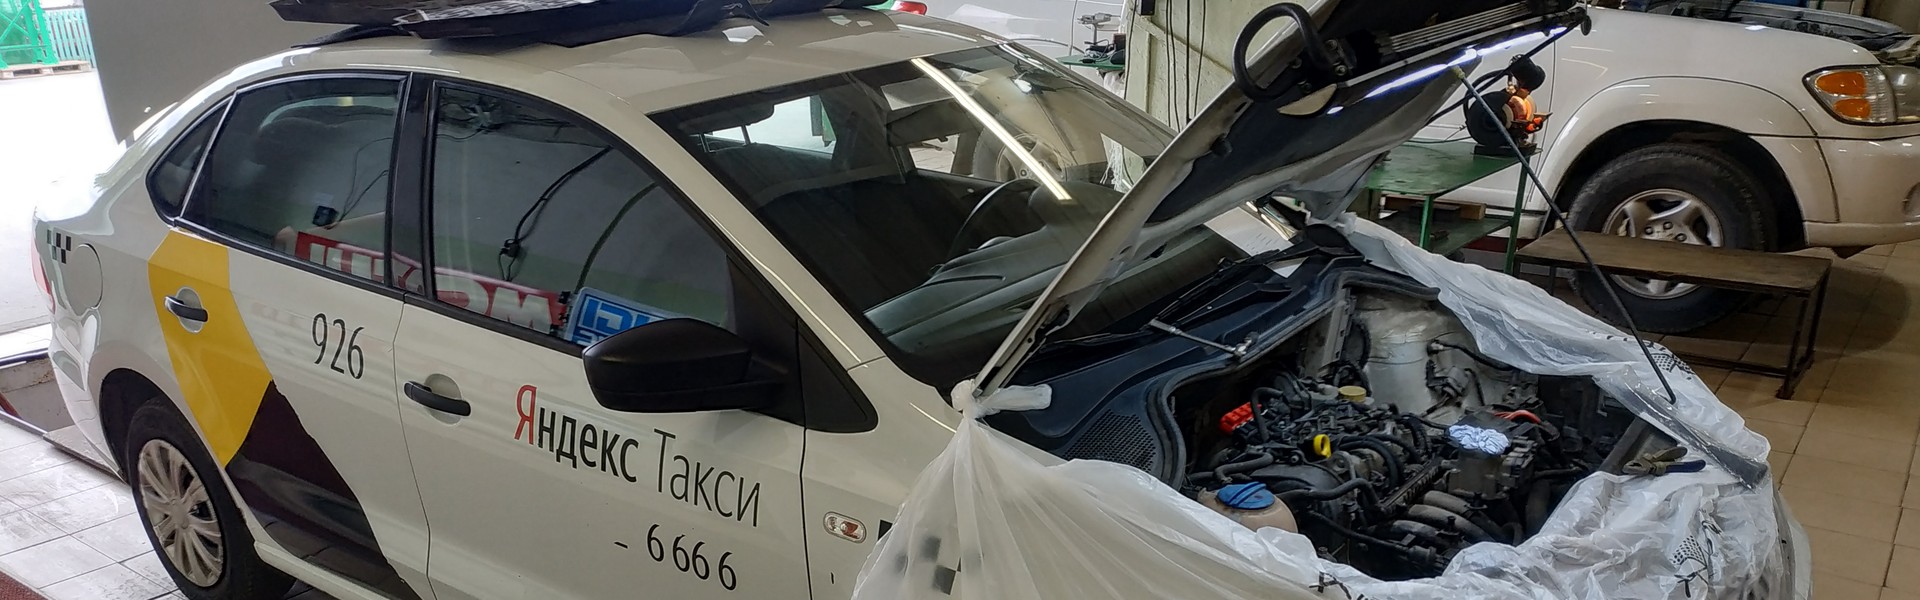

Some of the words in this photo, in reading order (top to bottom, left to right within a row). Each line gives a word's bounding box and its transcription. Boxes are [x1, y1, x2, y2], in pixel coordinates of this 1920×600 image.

[312, 312, 365, 380] 926
[513, 384, 640, 483] Яндекс
[653, 428, 761, 528] Такси
